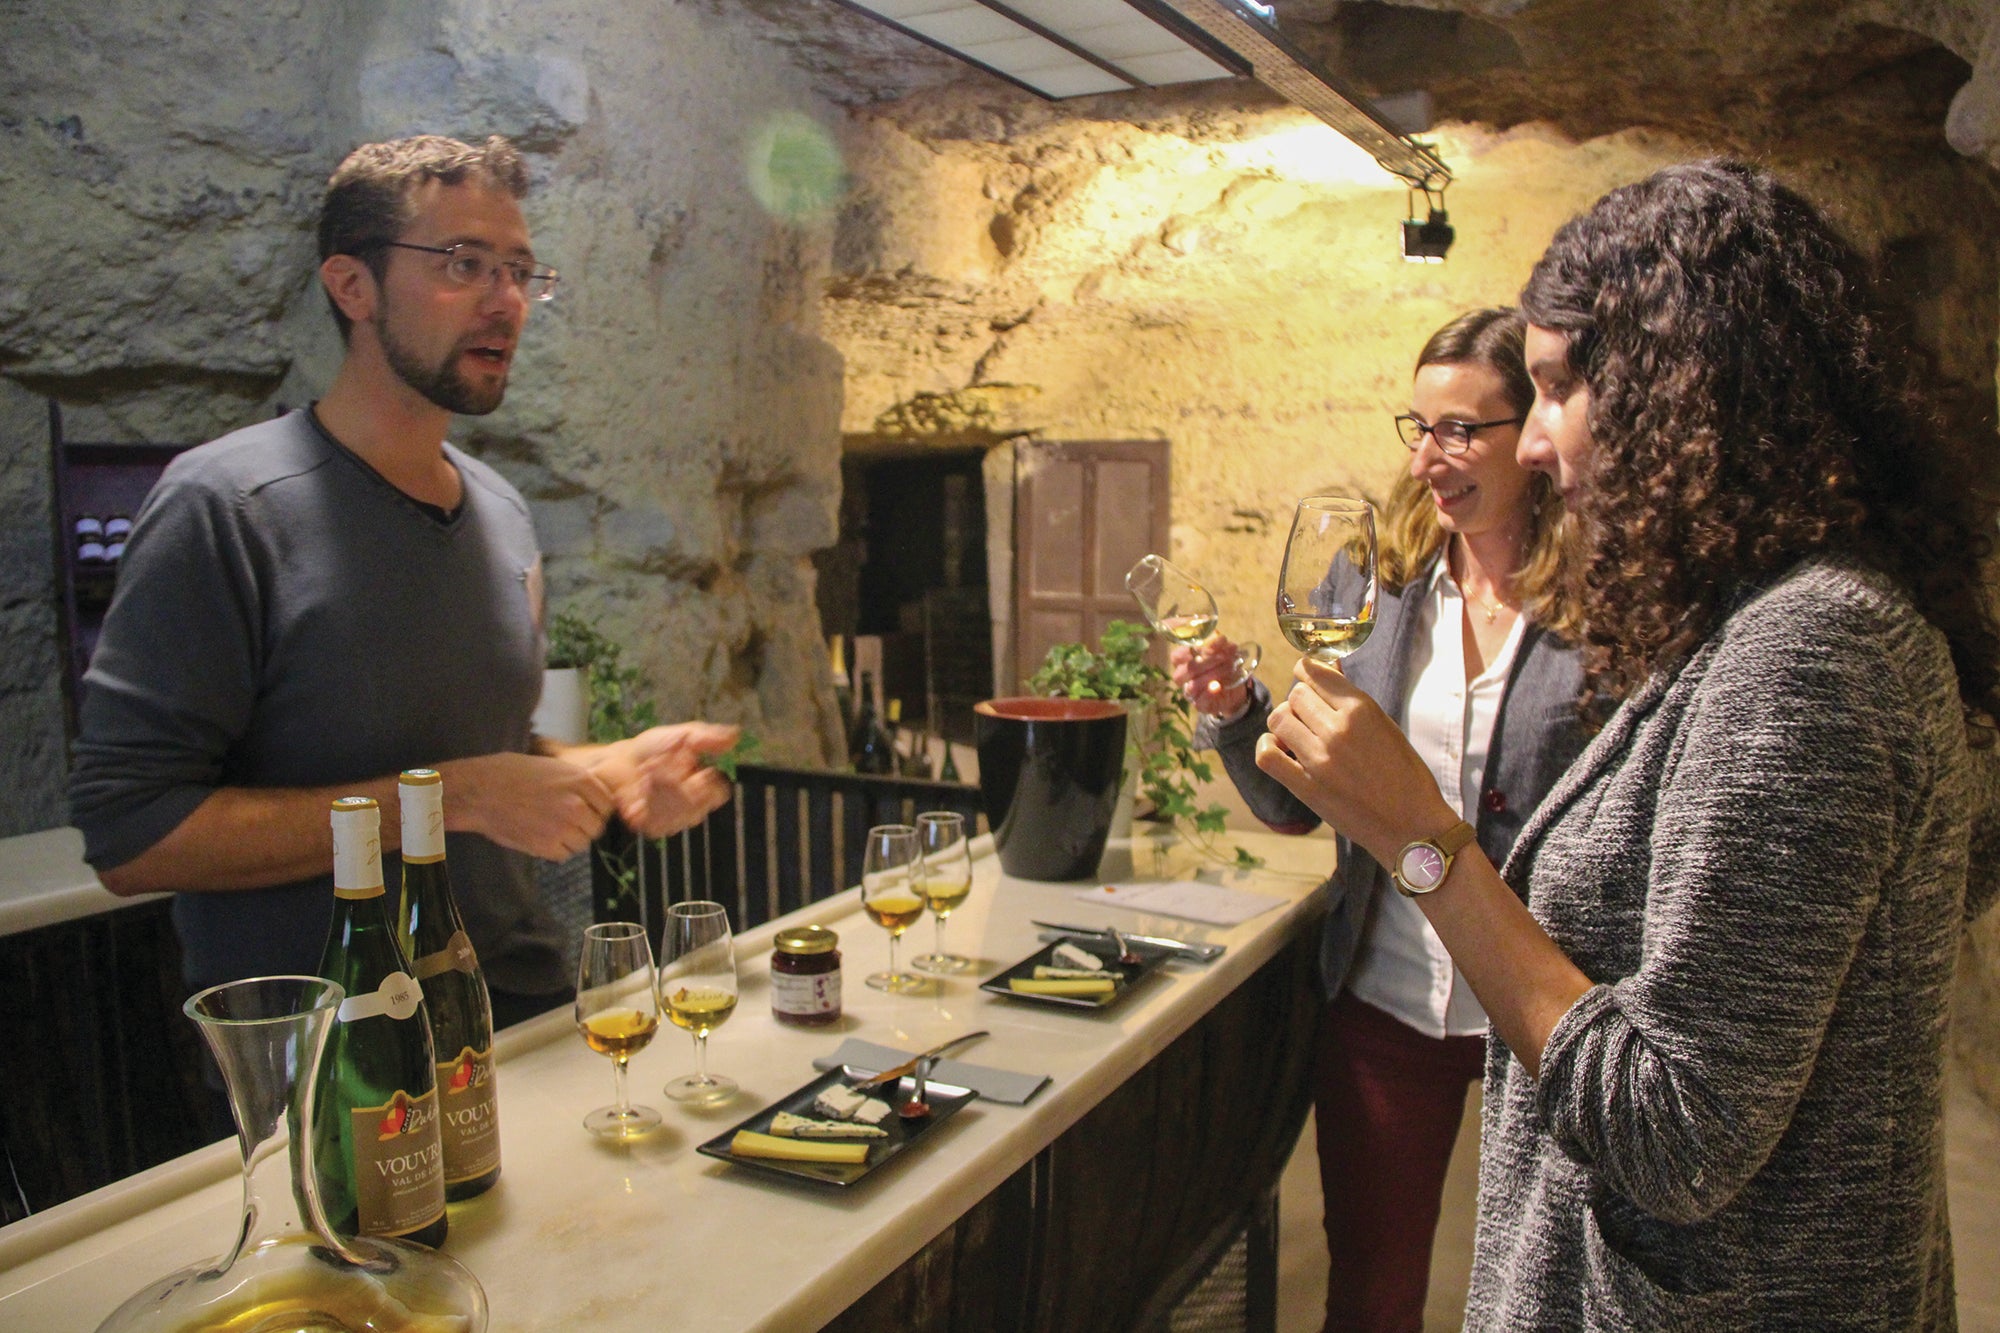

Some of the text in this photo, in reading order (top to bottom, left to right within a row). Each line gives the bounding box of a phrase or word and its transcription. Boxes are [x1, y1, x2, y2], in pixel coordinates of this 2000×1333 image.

[390, 991, 410, 1006] 1985
[375, 1142, 440, 1177] VOUVR
[392, 1176, 412, 1187] VAL
[415, 1170, 427, 1181] DE
